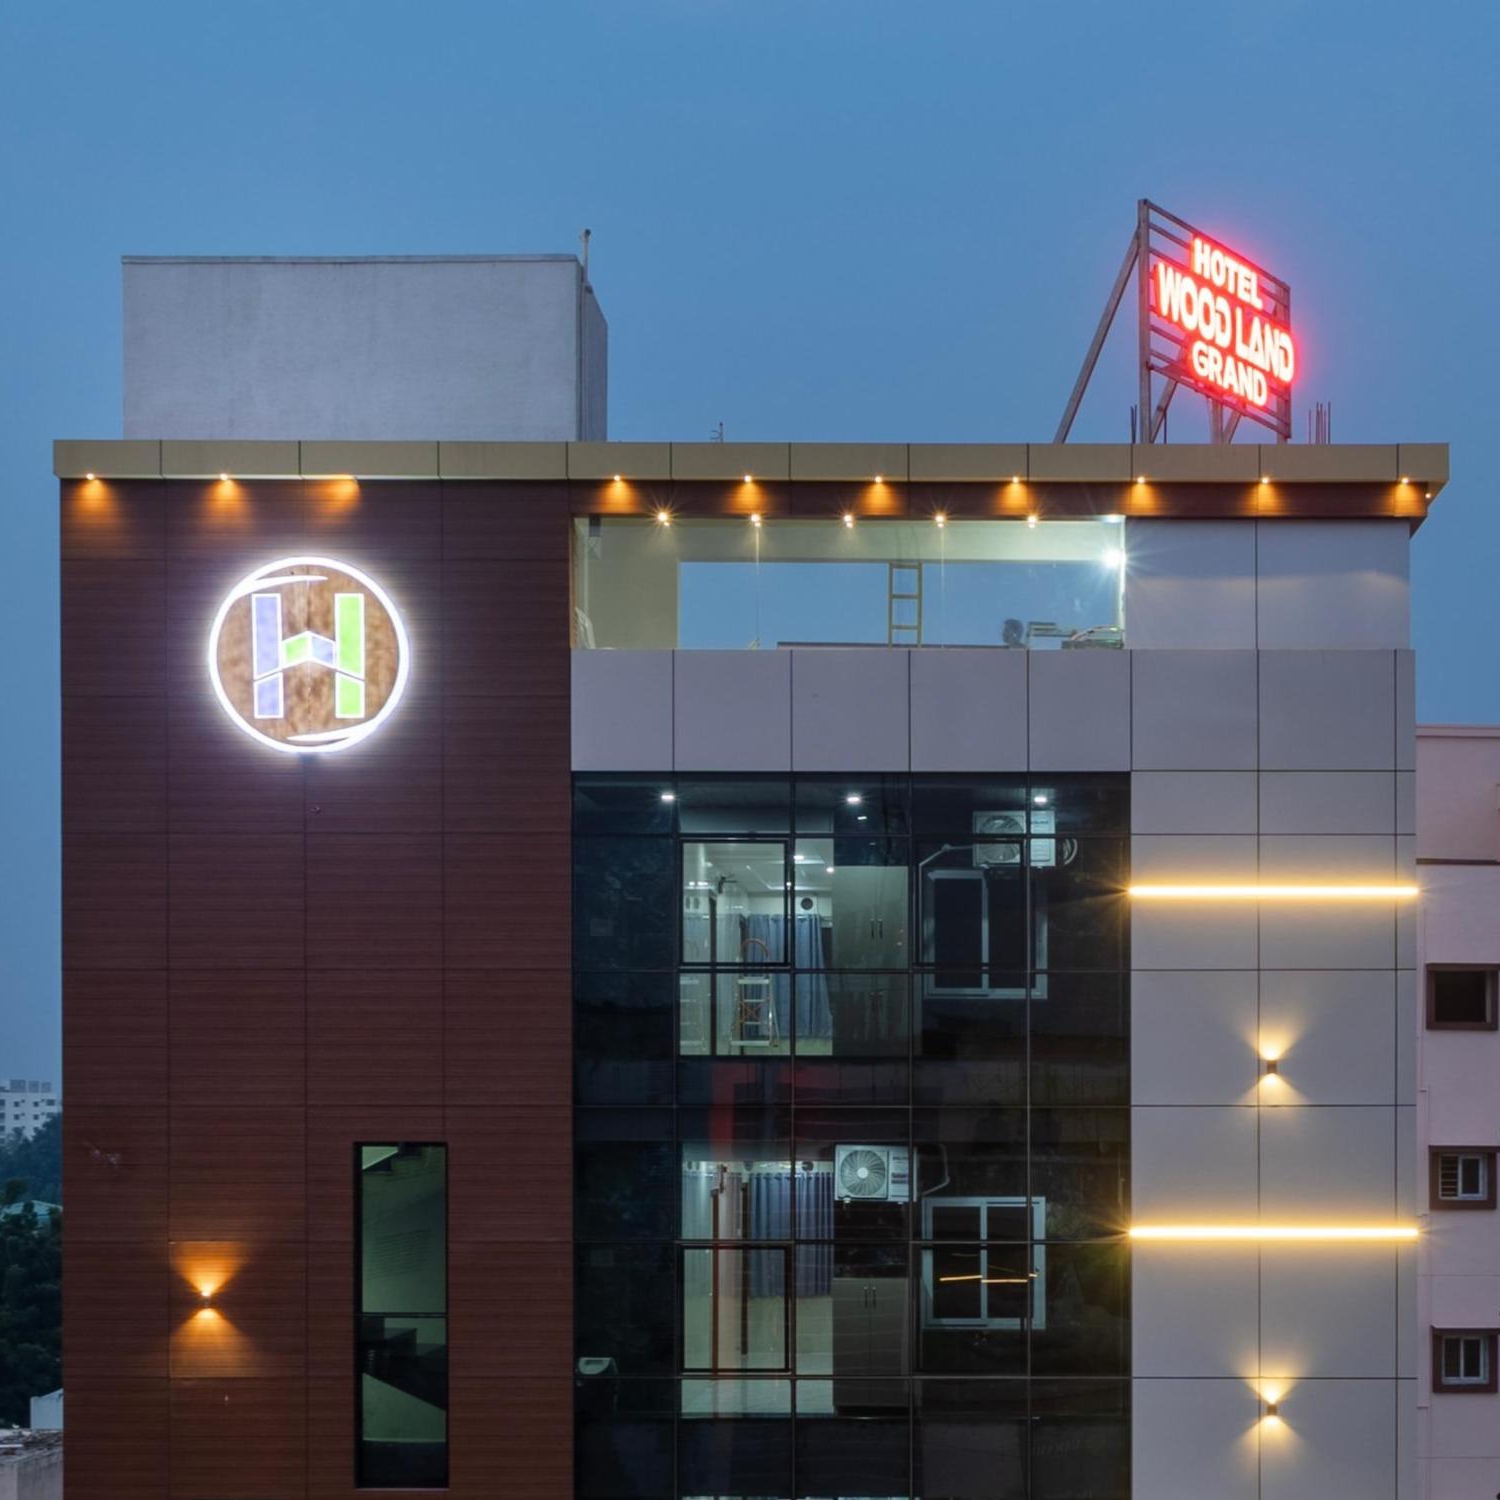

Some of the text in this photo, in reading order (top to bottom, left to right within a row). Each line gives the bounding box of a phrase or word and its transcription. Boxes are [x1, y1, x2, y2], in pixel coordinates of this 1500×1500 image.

[1193, 236, 1263, 310] HOTEL
[1156, 261, 1295, 383] WOOD LAND
[1191, 340, 1268, 407] GRAND
